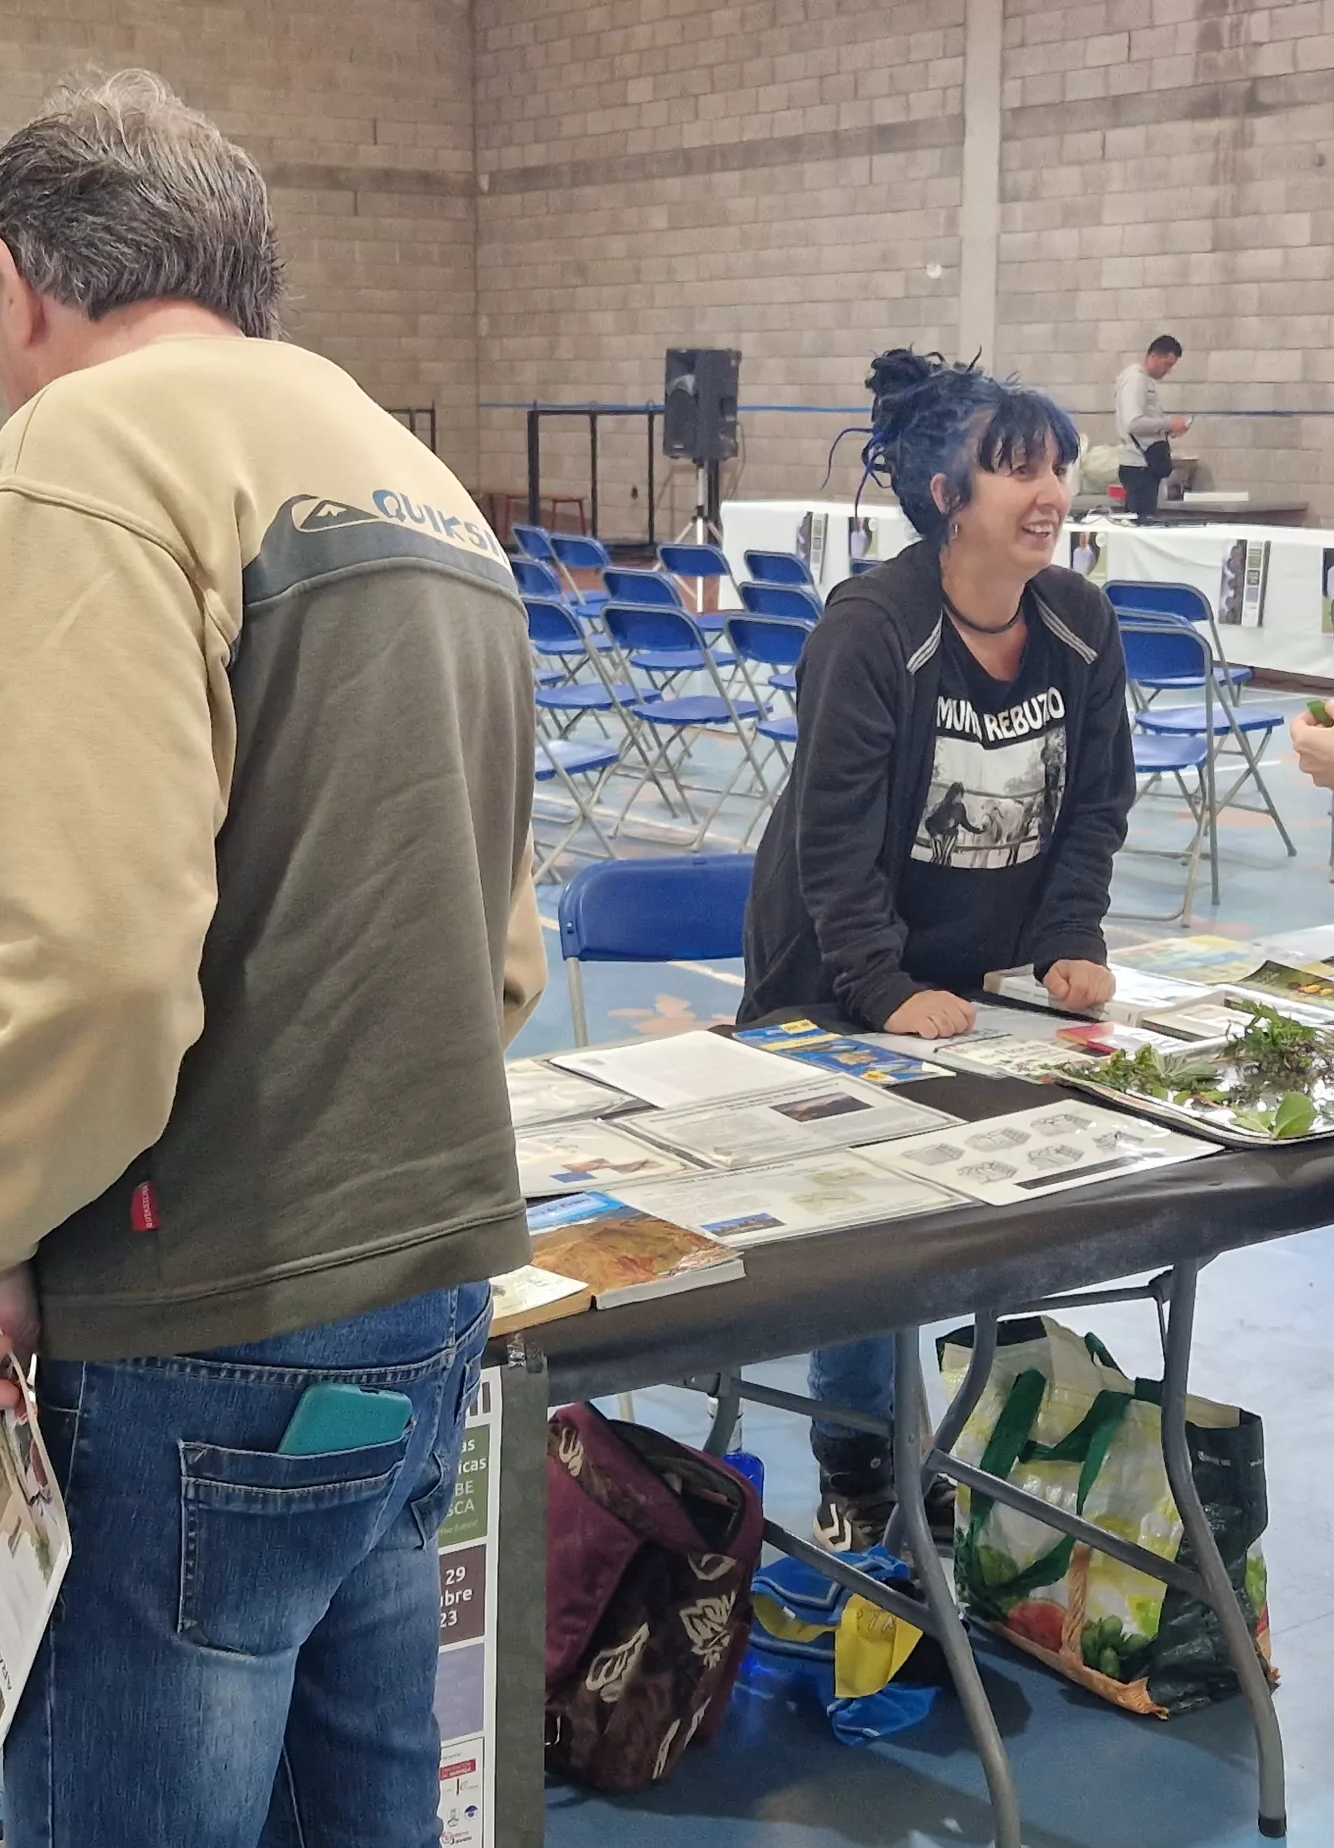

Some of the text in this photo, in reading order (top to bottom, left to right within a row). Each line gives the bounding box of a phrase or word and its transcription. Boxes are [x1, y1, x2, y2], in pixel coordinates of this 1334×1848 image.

[372, 489, 505, 564] QUIKSI
[936, 695, 983, 740] MUN
[459, 1436, 476, 1453] as
[458, 1456, 487, 1476] icas
[454, 1480, 475, 1498] BE
[446, 1500, 476, 1519] SCA
[445, 1565, 466, 1586] 29
[439, 1585, 474, 1608] ubre
[439, 1609, 458, 1629] 23
